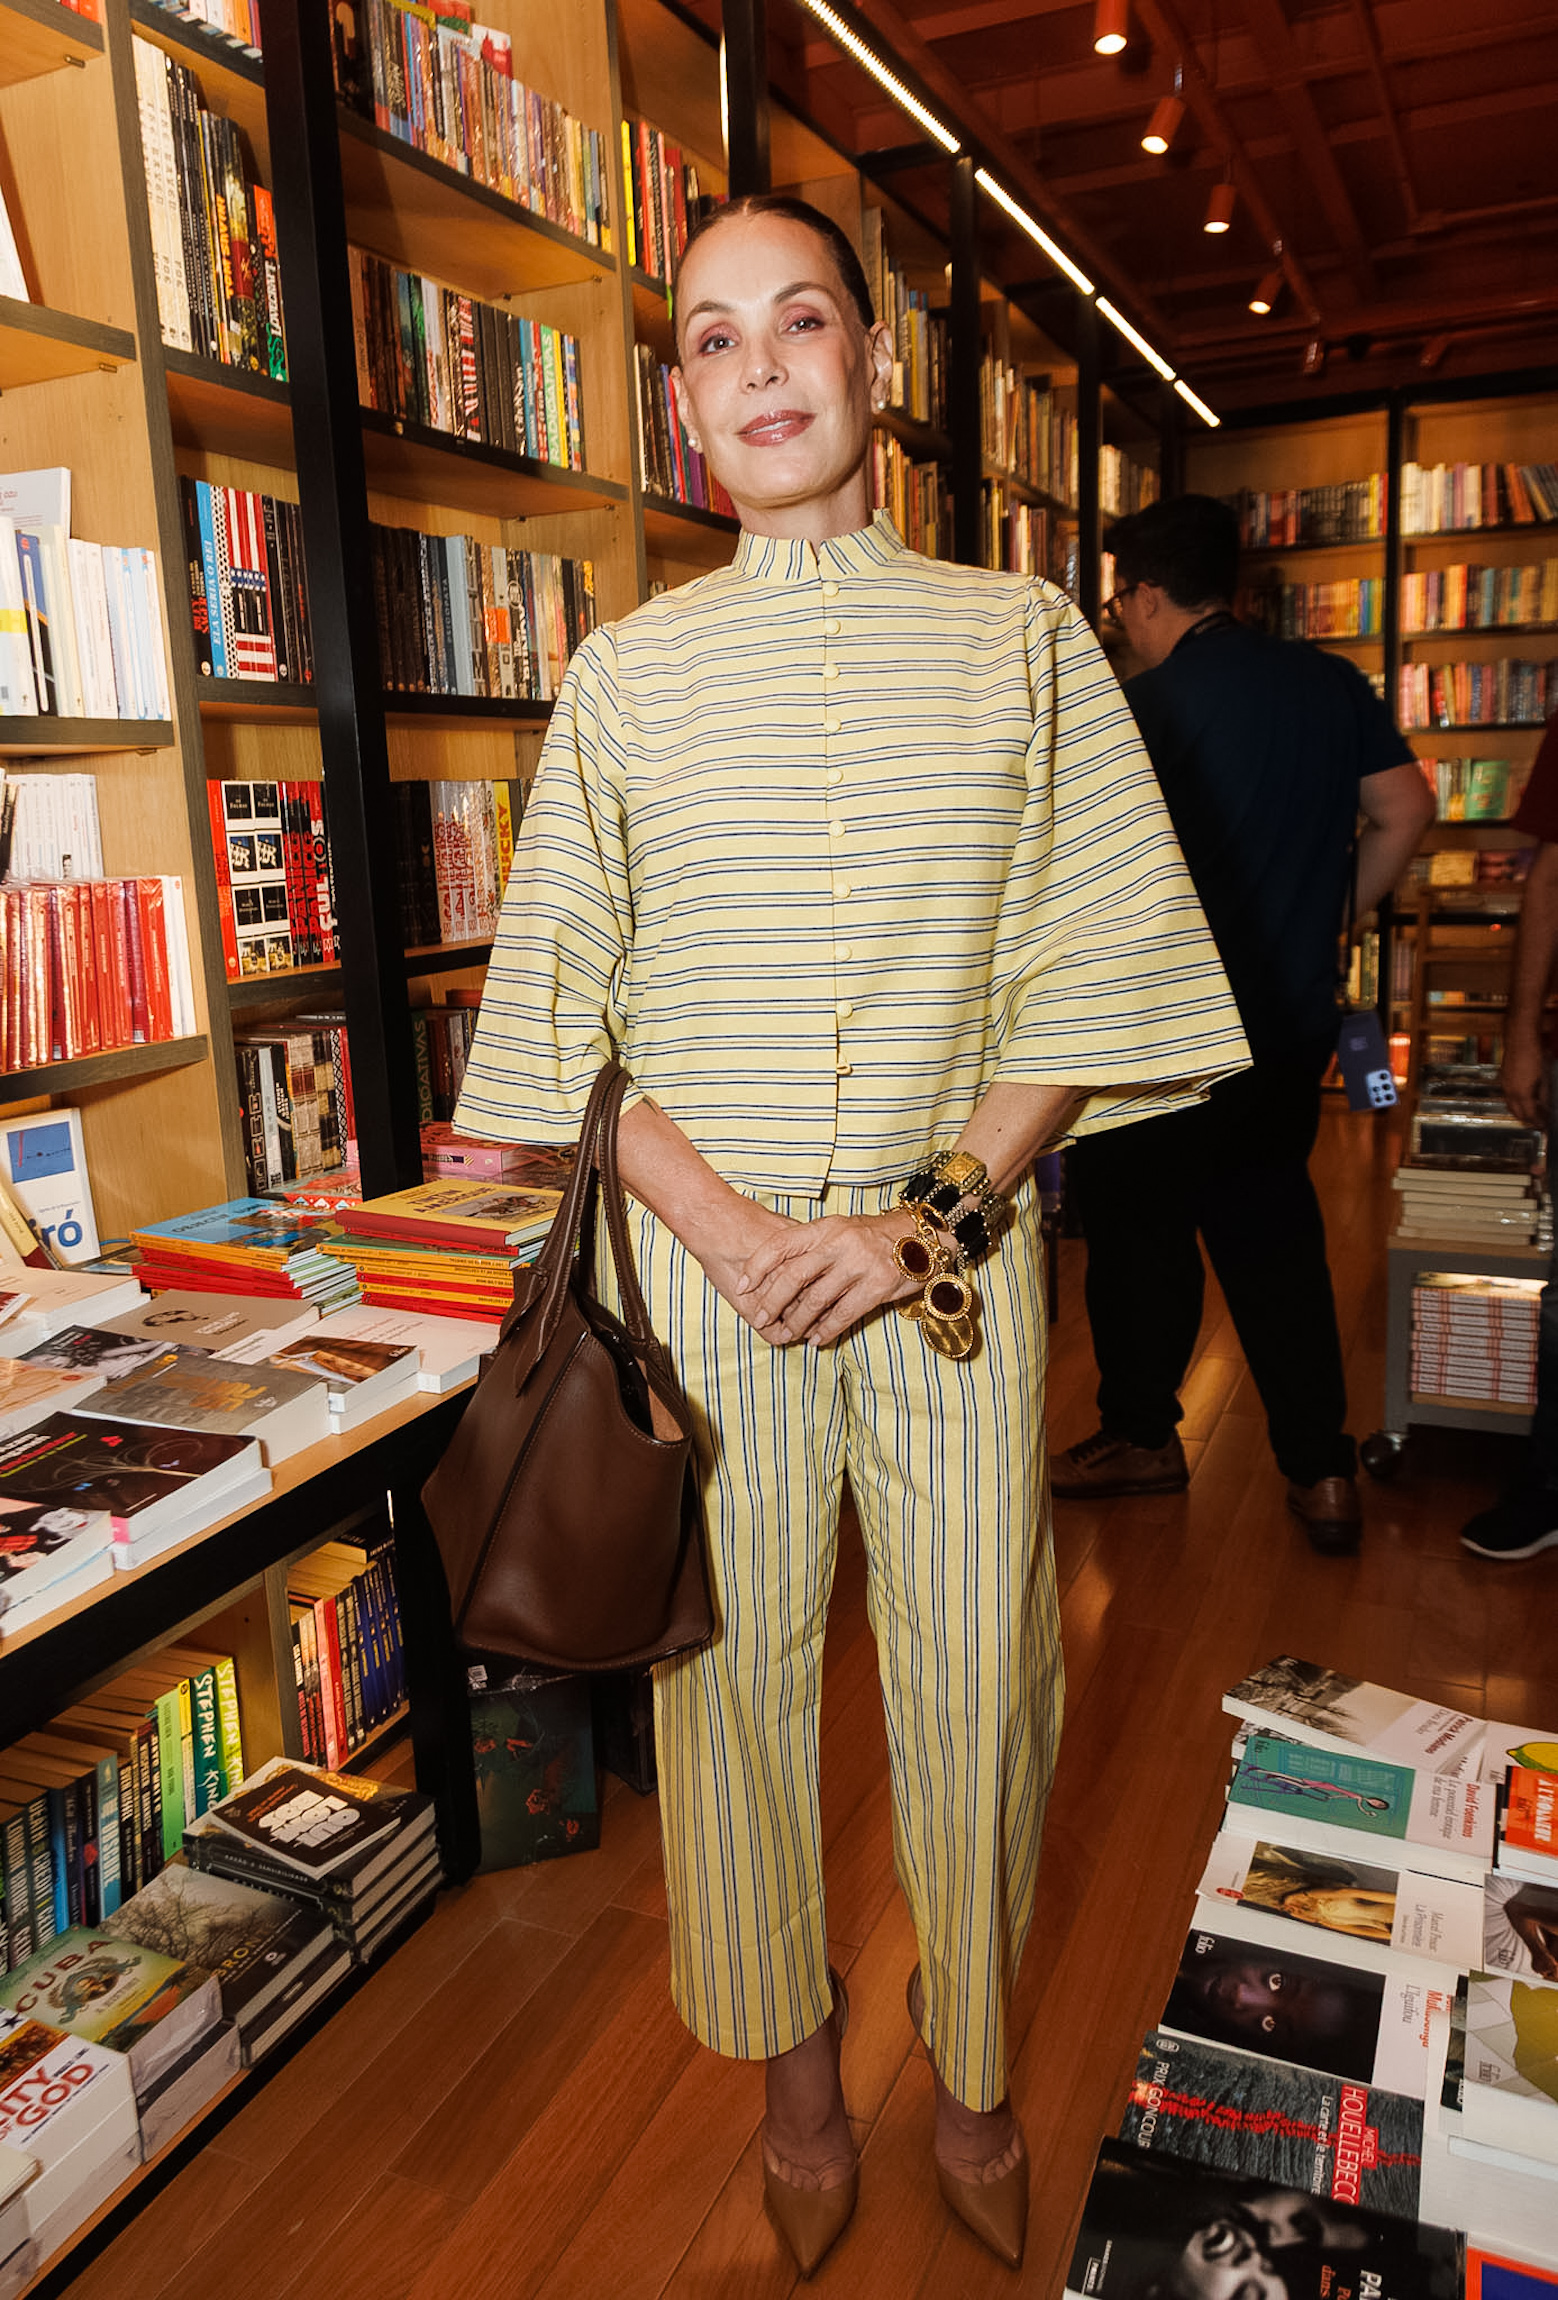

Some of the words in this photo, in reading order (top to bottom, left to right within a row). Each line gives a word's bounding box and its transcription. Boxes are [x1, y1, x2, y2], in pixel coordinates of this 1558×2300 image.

[264, 261, 282, 337] LOVECRAFT
[204, 540, 213, 563] REI
[205, 565, 214, 576] O
[207, 578, 219, 618] SERIA
[442, 577, 452, 644] PSICOPATA
[212, 620, 221, 645] ELA
[414, 1019, 433, 1121] DIOATIVAS
[28, 1207, 83, 1251] ró
[194, 1673, 217, 1758] STEPHEN
[217, 1662, 238, 1745] STEPHEN
[1465, 1783, 1480, 1803] David
[28, 1798, 48, 1844] DEATH
[1462, 1804, 1479, 1838] Foenkinos
[6, 1817, 26, 1873] LONDON
[101, 1820, 120, 1888] OBSCURE
[10, 1869, 29, 1921] BRIDGE
[34, 1852, 53, 1901] CREDIT
[1195, 1935, 1215, 1954] folio
[16, 1940, 113, 2012] CUBA
[1151, 2061, 1172, 2085] PRIX
[16, 2063, 94, 2126] GOD
[1321, 2095, 1334, 2106] La
[1137, 2087, 1164, 2148] GONCOUR
[1317, 2130, 1330, 2141] et
[1318, 2106, 1333, 2129] carte
[1316, 2143, 1329, 2153] le
[1360, 2126, 1377, 2165] MICHEL
[1319, 2265, 1336, 2300] dans
